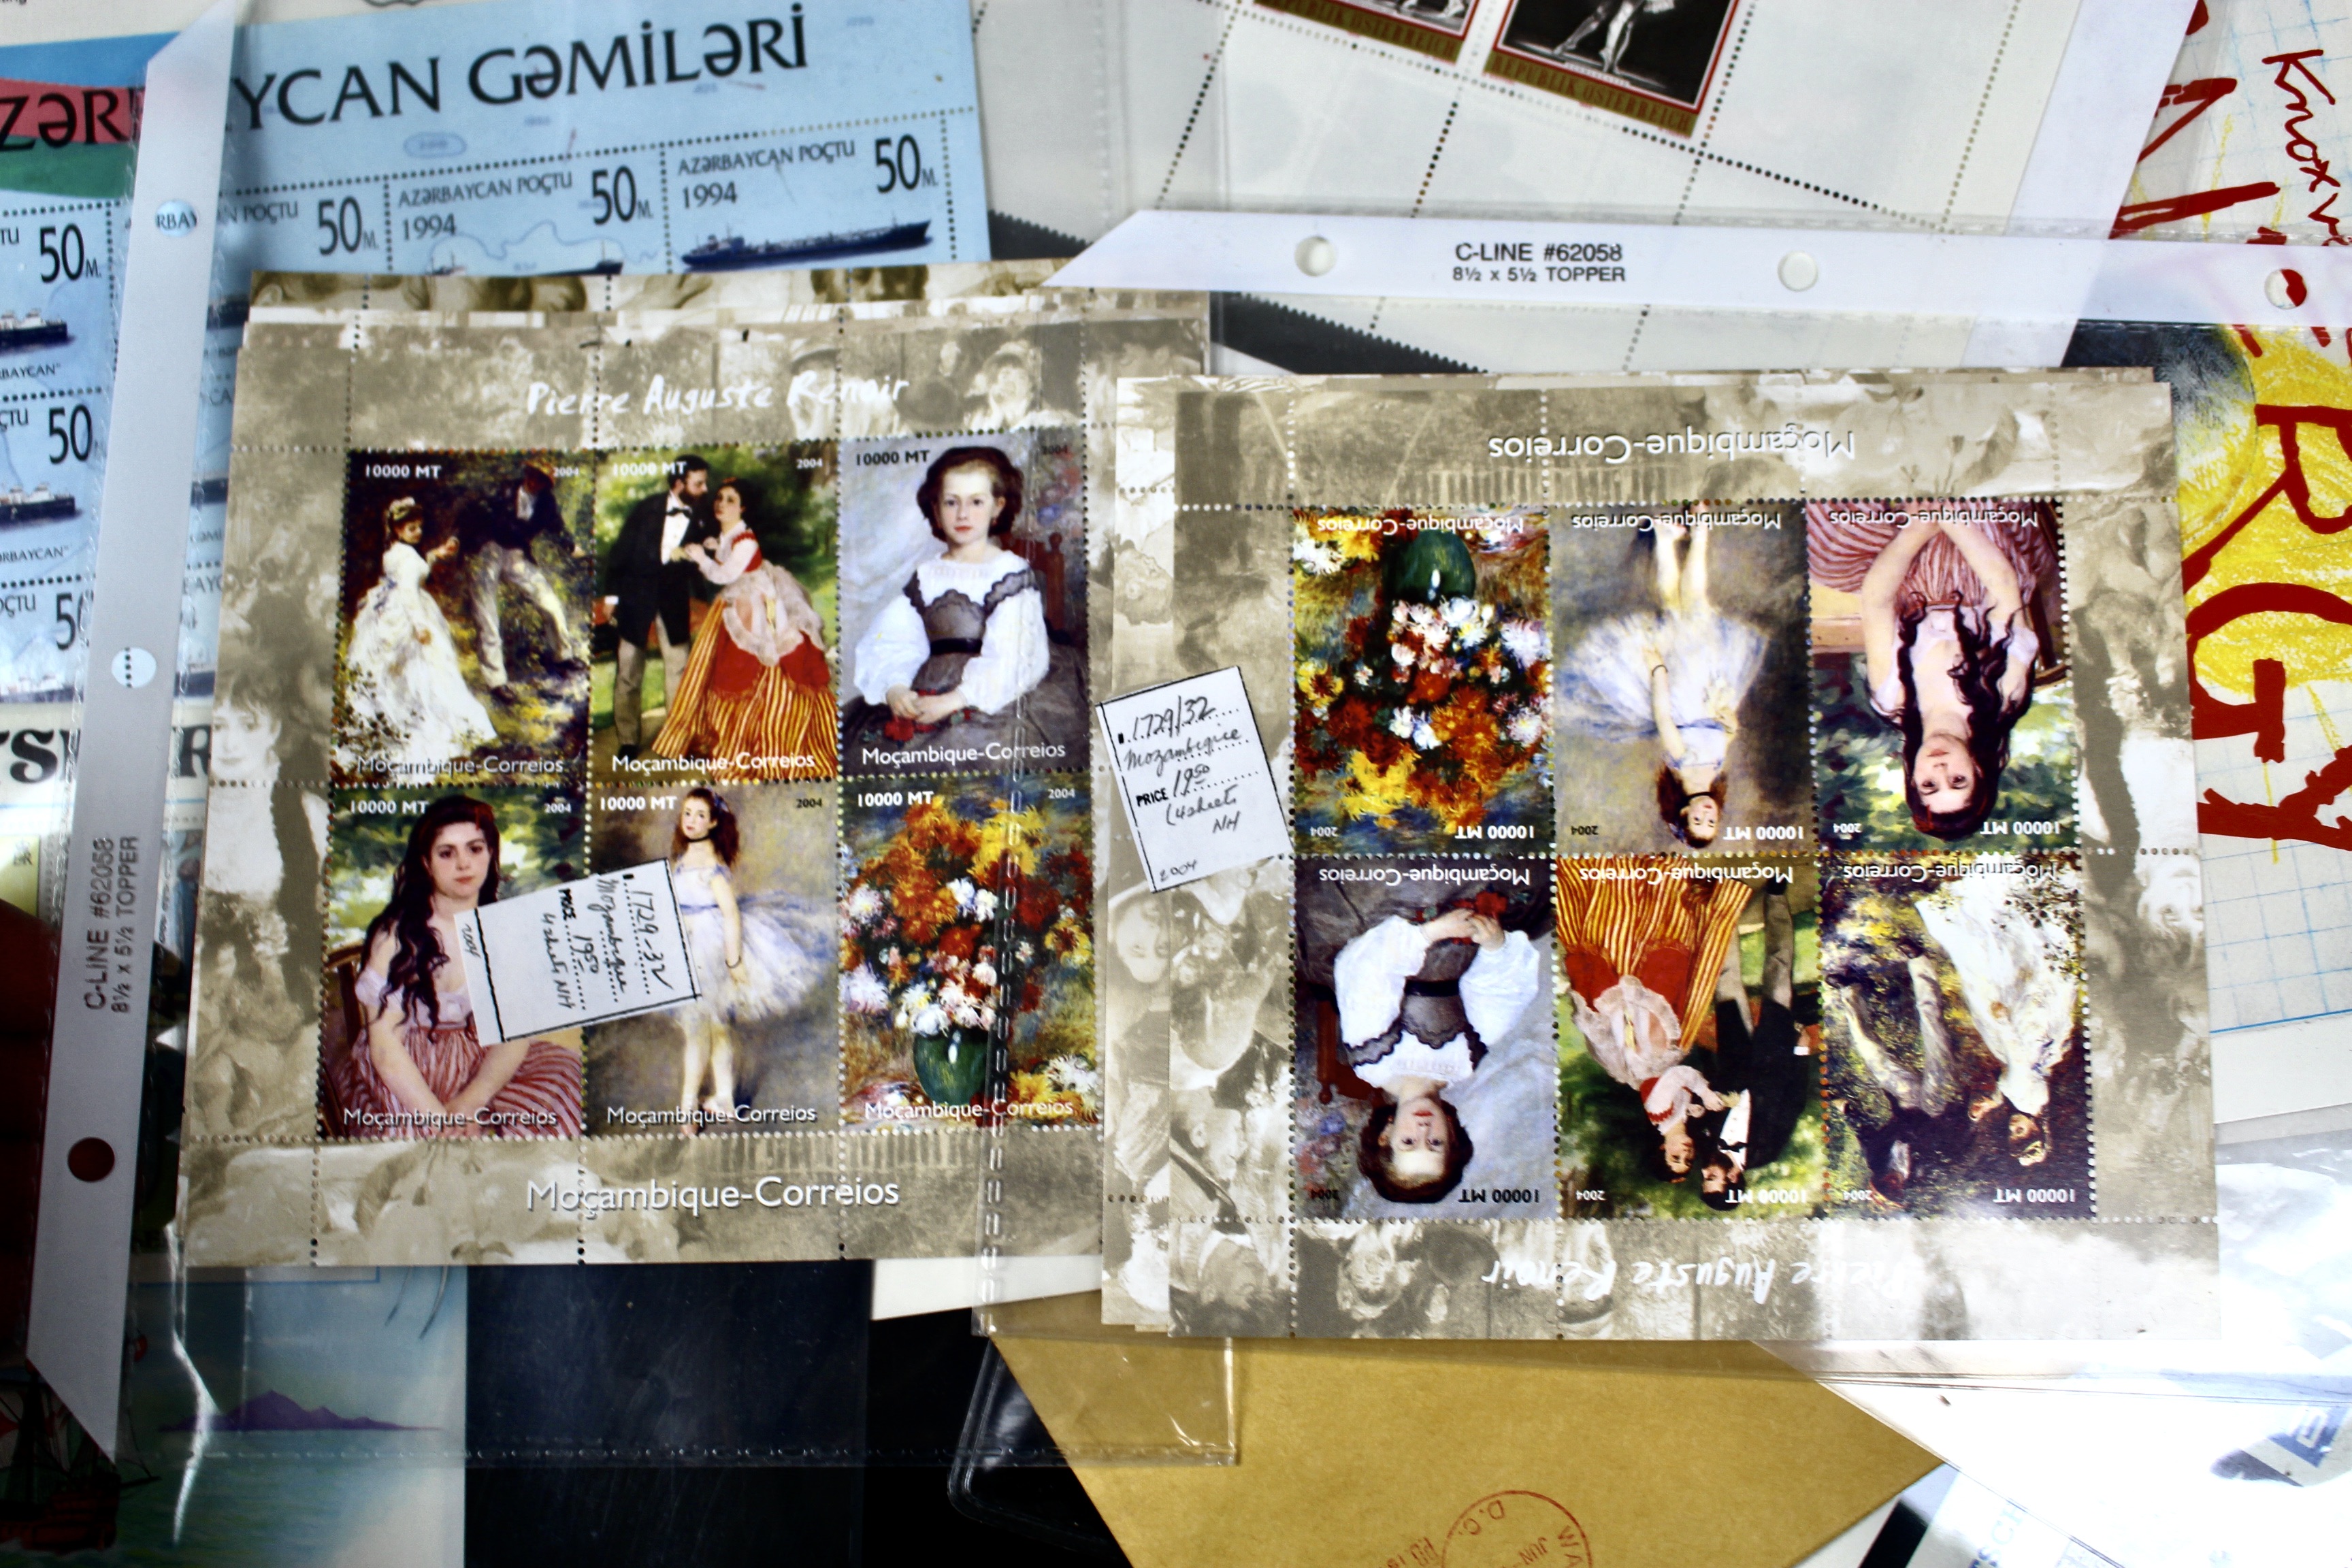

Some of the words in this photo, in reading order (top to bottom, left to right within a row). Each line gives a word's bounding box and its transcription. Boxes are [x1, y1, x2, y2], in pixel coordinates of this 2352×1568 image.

[798, 140, 856, 163] POÇTU
[517, 172, 573, 195] POÇTU
[683, 181, 738, 209] 1994
[402, 213, 457, 242] 1994
[1455, 242, 1533, 261] C-LINE
[1544, 243, 1623, 262] #62058
[1490, 270, 1499, 281] x
[1546, 267, 1626, 282] TOPPER
[527, 380, 630, 416] Pierre
[642, 374, 773, 416] Auguste
[786, 370, 910, 408] Renoir
[1488, 423, 1856, 464] Moçambique-Correios
[612, 462, 657, 476] 10000
[662, 460, 687, 475] MT
[796, 457, 823, 469] 2004
[856, 451, 900, 466] 10000
[904, 449, 930, 463] MT
[365, 464, 410, 478] 10000
[414, 464, 442, 478] MT
[553, 466, 579, 477] 2004
[1317, 510, 1524, 536] Moçambique-Correios
[1571, 507, 1781, 532] Moçambique-Correios
[1829, 504, 2040, 529] Moçambique-Correios
[612, 751, 816, 777] Moçambique-Correios
[862, 742, 1066, 769] Moçambique-Correios
[357, 755, 564, 779] Moçambique-Correios
[350, 800, 397, 814] 10000
[402, 799, 429, 814] MT
[544, 802, 572, 813] 2004
[600, 796, 646, 811] 10000
[651, 796, 678, 811] MT
[796, 798, 823, 808] 2004
[858, 792, 903, 807] 10000
[907, 791, 934, 805] MT
[1047, 787, 1076, 799] 2004
[1135, 788, 1169, 807] PRICE
[1309, 826, 1339, 837] 2004
[1454, 826, 1482, 839] MT
[1487, 826, 1535, 839] 10000
[1570, 825, 1599, 836] 2004
[1723, 826, 1751, 840] MT
[1756, 826, 1803, 840] 10000
[1833, 823, 1862, 834] 2004
[1980, 821, 2008, 835] MT
[2012, 821, 2060, 835] 10000
[89, 836, 114, 919] #62058
[116, 836, 139, 917] TOPPER
[1159, 859, 1197, 883] 2004
[1319, 863, 1531, 886] Moçambique-Correios
[1580, 862, 1794, 885] Moçambique-Correios
[1844, 858, 2057, 883] Moçambique-Correios
[558, 888, 577, 921] PRICE
[84, 927, 109, 1011] C-LINE
[117, 962, 132, 975] x
[342, 1107, 558, 1130] Moçambique-Correios
[606, 1104, 817, 1129] Moçambique-Correios
[864, 1098, 1074, 1122] Moçambique-Correios
[526, 1175, 900, 1219] Moçambique-Correios
[1458, 1189, 1486, 1203] MT
[1491, 1189, 1540, 1203] 10000
[1575, 1190, 1606, 1201] 2004
[1725, 1189, 1753, 1204] MT
[1759, 1189, 1807, 1204] 10000
[1843, 1189, 1872, 1200] 2004
[1992, 1188, 2022, 1203] MT
[2026, 1188, 2076, 1203] 10000
[1482, 1259, 1618, 1303] Renoir
[1631, 1258, 1776, 1305] Auguste
